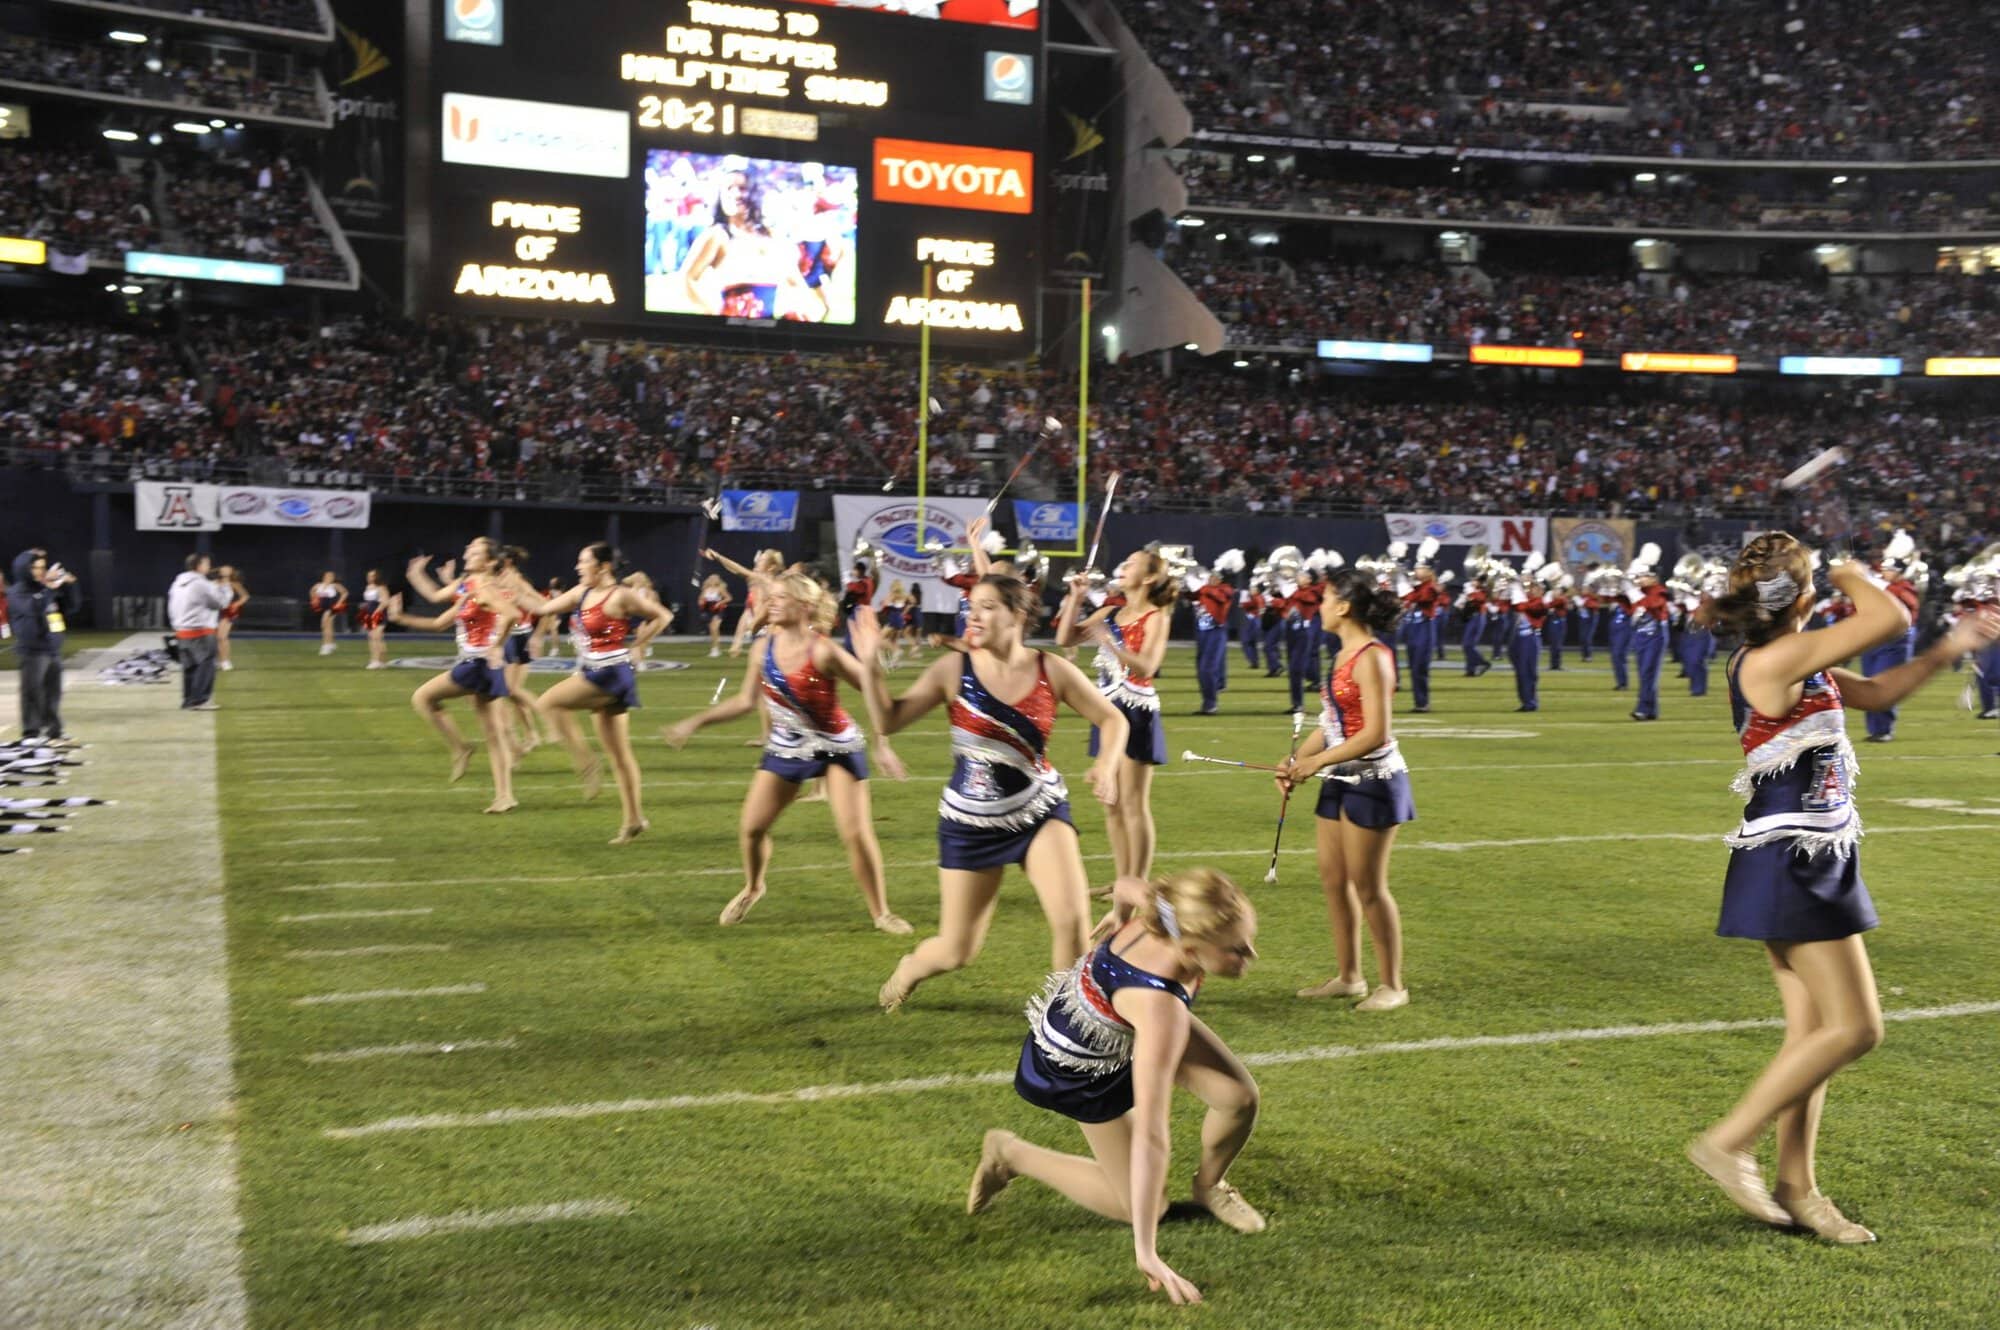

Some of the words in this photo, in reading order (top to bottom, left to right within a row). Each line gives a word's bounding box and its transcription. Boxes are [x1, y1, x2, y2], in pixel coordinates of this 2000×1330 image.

[784, 11, 819, 36] TO
[666, 26, 713, 56] DR
[721, 33, 838, 71] PEPPER
[881, 157, 1025, 198] TOYOTA
[491, 201, 581, 233] PRIDE
[515, 235, 557, 261] OF
[917, 237, 995, 266] PRIDE
[454, 263, 616, 304] ARIZONA
[937, 269, 974, 292] OF
[884, 296, 1024, 332] ARIZONA
[157, 486, 201, 527] A
[1502, 520, 1534, 553] N
